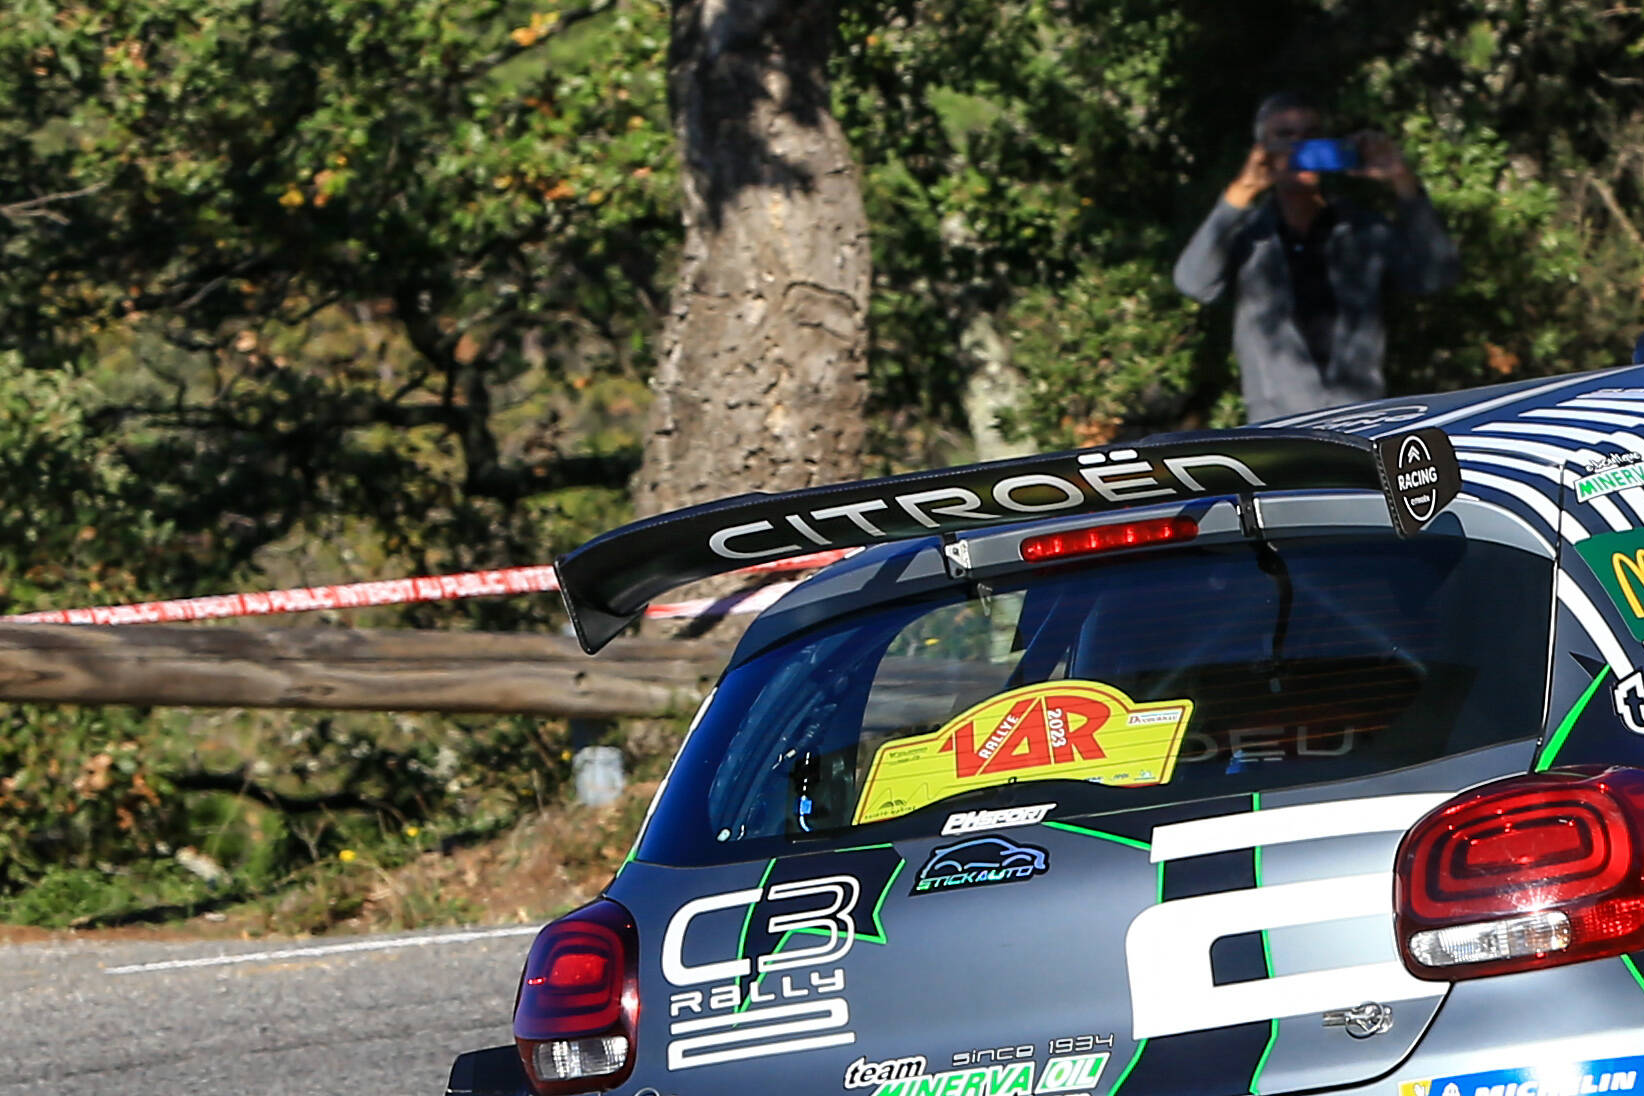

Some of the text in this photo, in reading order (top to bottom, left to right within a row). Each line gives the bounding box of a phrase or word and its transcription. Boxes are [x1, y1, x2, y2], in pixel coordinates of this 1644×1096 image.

[1398, 466, 1438, 491] RACING
[939, 695, 1111, 778] VAR
[979, 713, 1020, 760] RALLYE
[1046, 708, 1067, 748] 2023
[661, 875, 861, 987] C3
[1048, 1034, 1114, 1054] 1934
[849, 1058, 922, 1084] team
[1045, 1056, 1110, 1089] OIL
